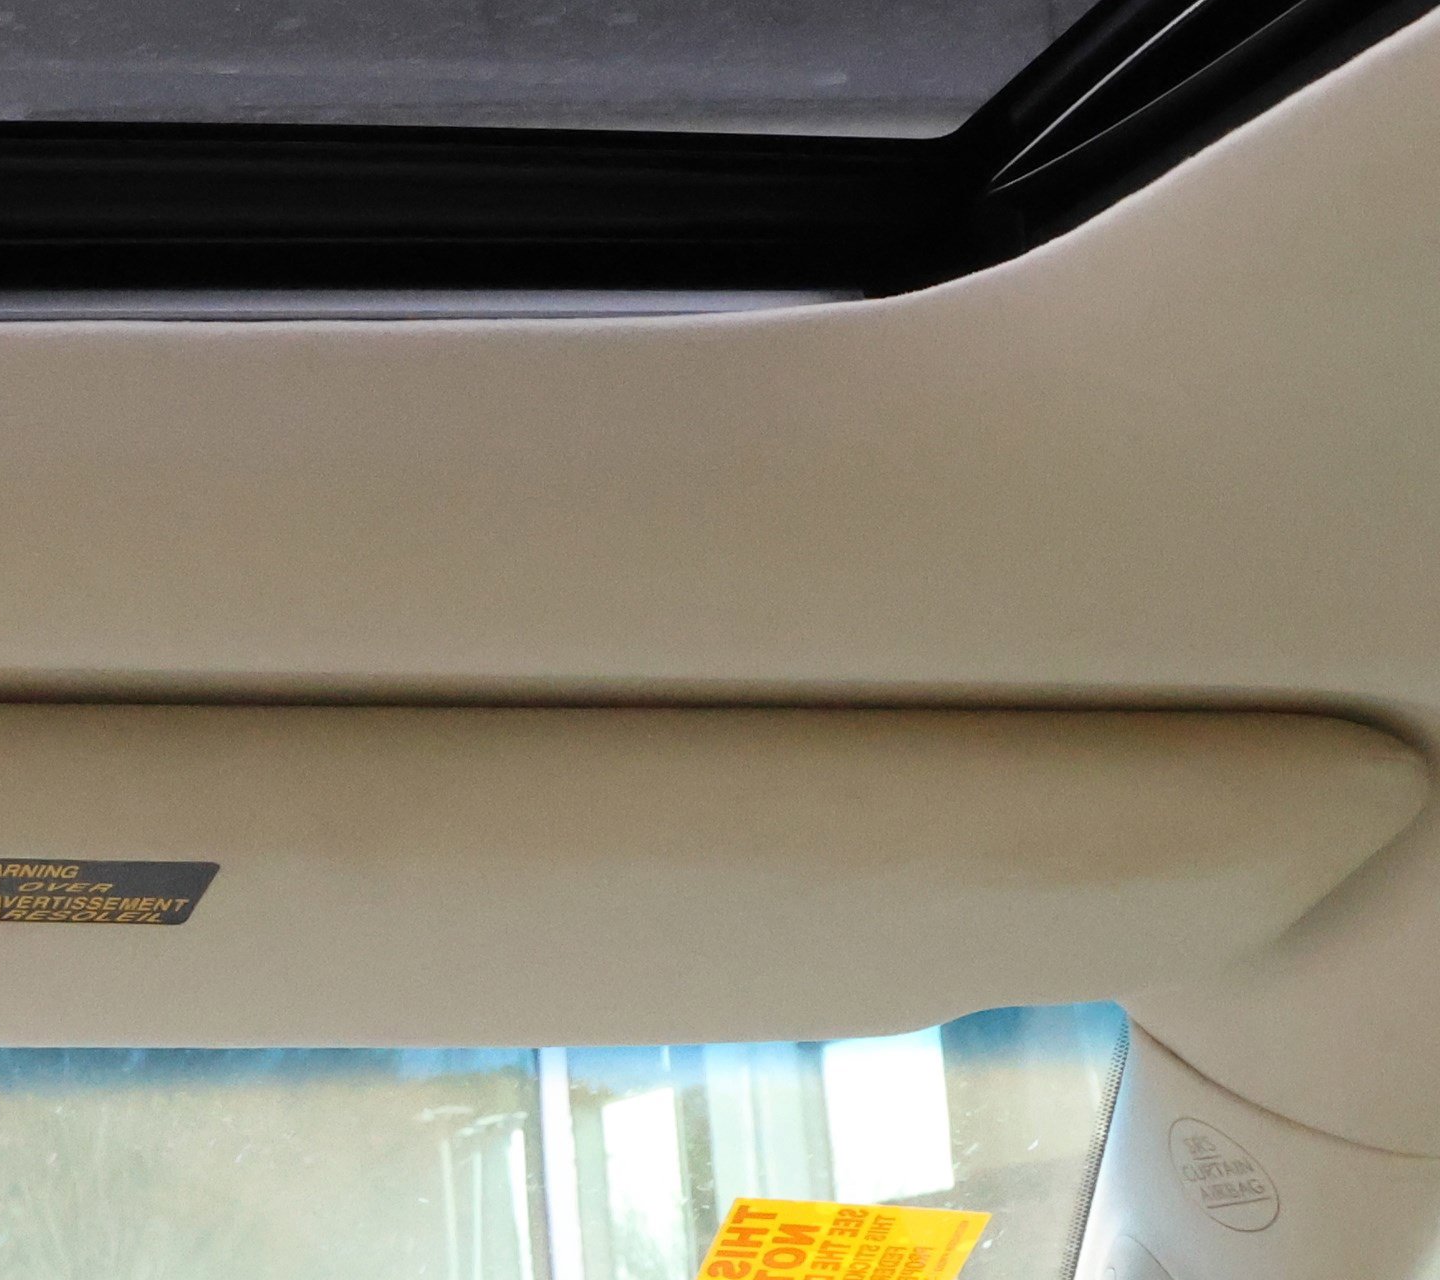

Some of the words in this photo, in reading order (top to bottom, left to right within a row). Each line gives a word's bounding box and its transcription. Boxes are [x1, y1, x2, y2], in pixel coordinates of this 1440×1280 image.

[17, 881, 114, 893] OVER
[1182, 1160, 1255, 1182] CURTAIN
[1199, 1179, 1266, 1202] AIRBAG
